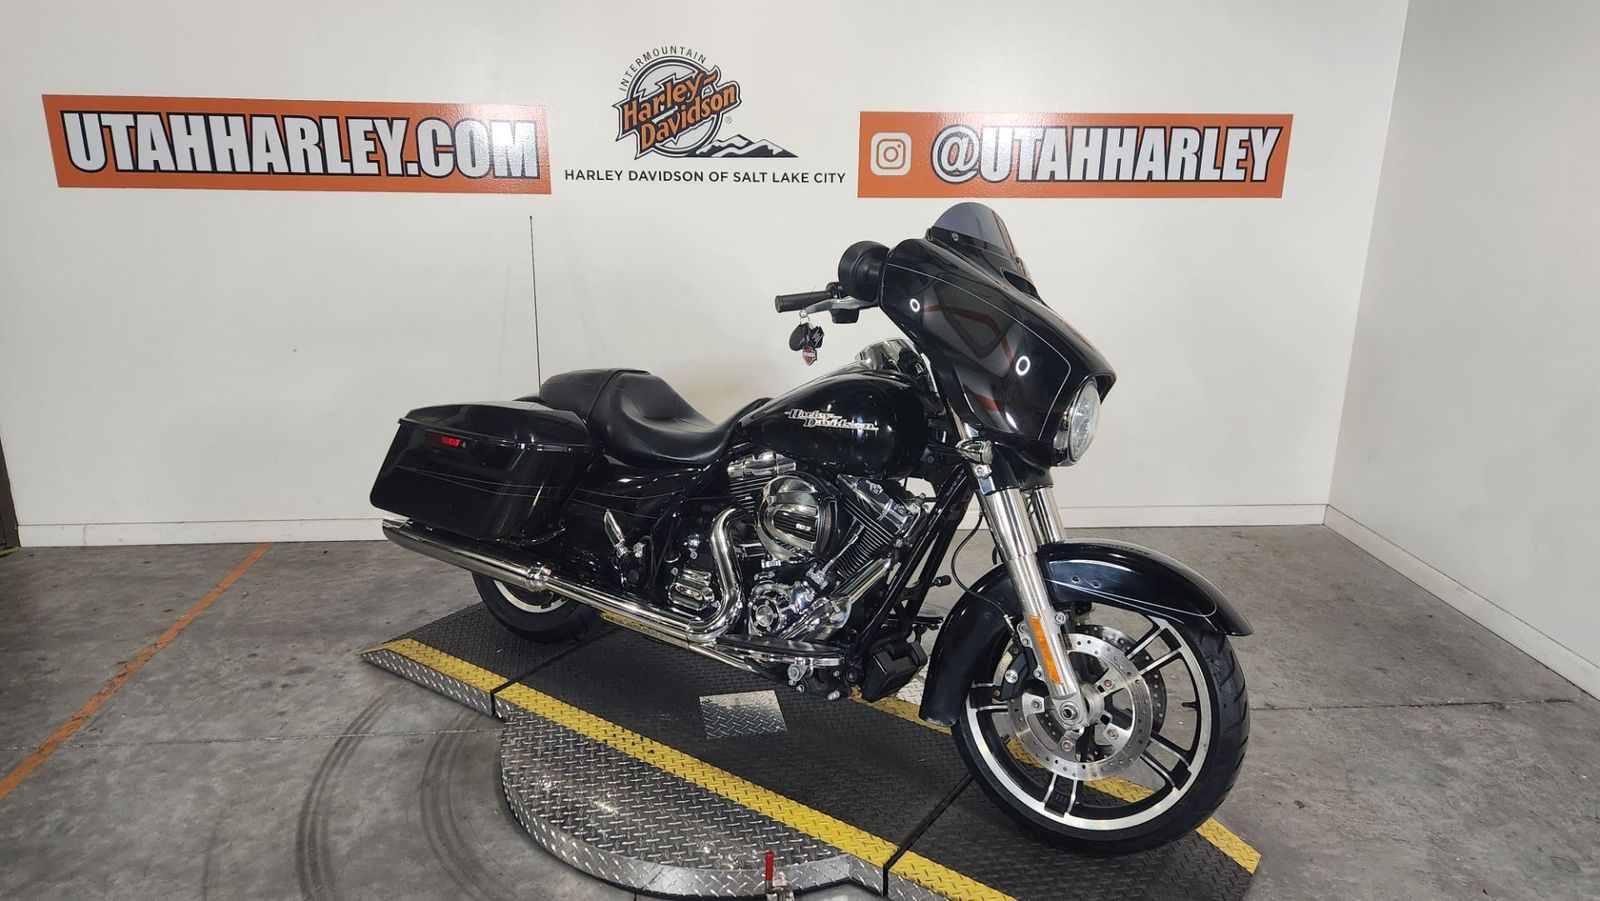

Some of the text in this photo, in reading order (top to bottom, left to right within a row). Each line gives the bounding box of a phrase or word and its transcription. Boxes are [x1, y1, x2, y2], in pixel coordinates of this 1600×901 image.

[619, 45, 707, 92] INTERMOUNTAIN
[60, 109, 541, 180] UTAHHARLEY.COM
[641, 84, 738, 151] Davidson
[564, 169, 846, 184] HARLEY DAVIDSON OF SALT LAKE CITY
[930, 124, 1284, 184] @UTAHHARLEY
